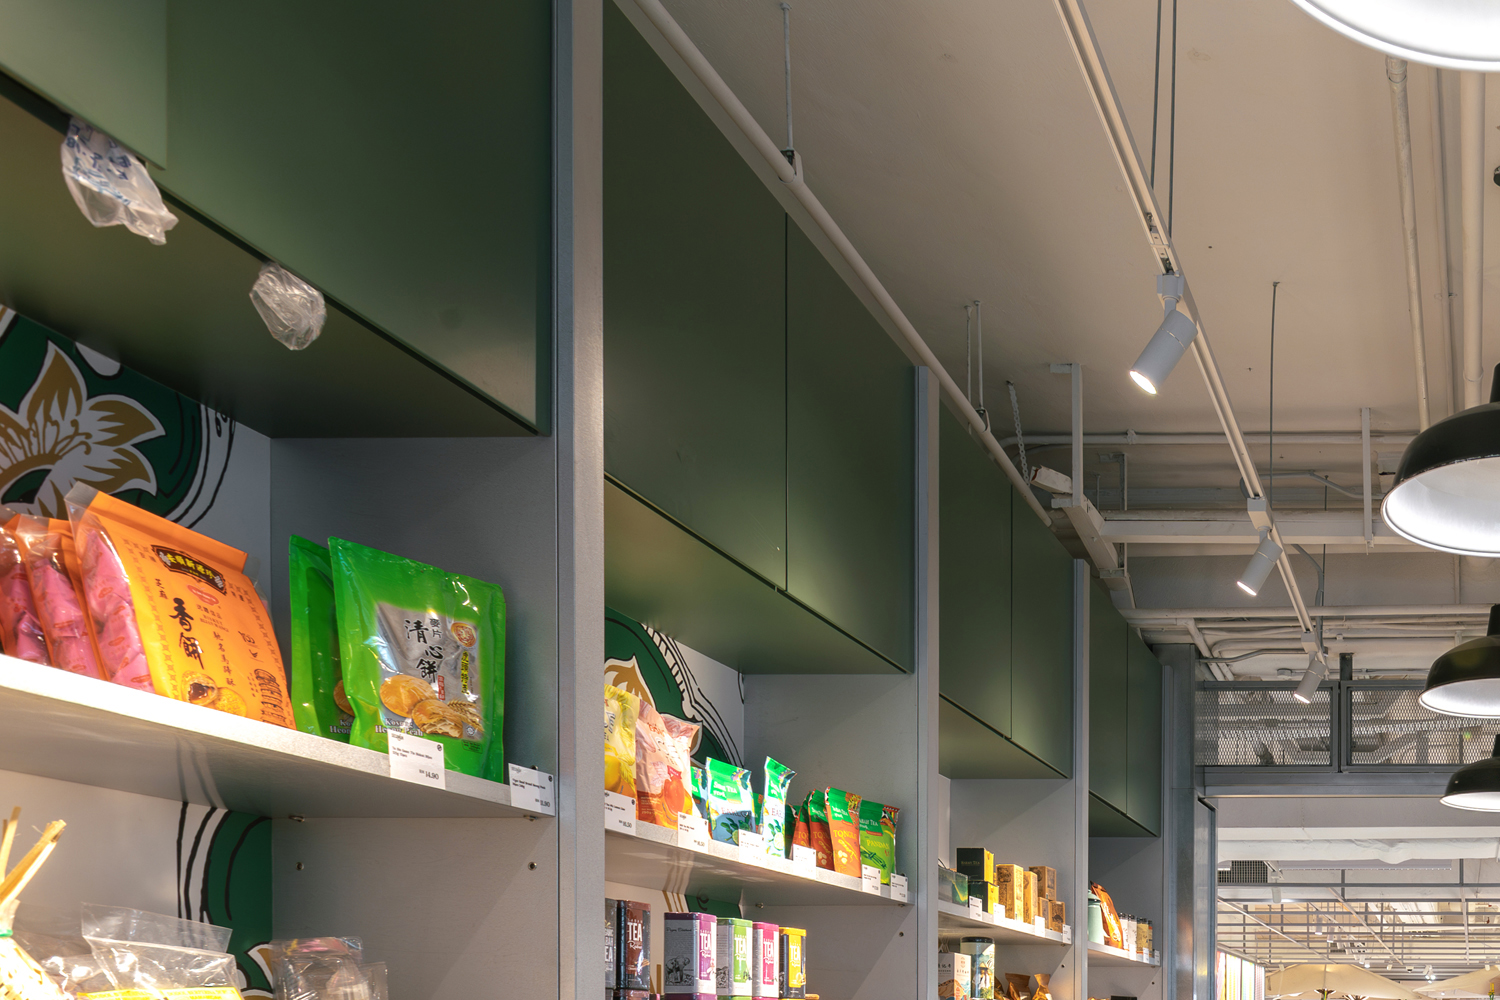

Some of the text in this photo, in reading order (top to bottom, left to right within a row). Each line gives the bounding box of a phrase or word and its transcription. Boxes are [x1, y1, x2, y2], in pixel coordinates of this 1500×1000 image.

[405, 619, 443, 683] 清心餅
[329, 725, 351, 735] Heon
[627, 922, 642, 942] TEA
[700, 933, 712, 950] TEA
[734, 936, 747, 954] TEA
[763, 940, 774, 958] TEA
[605, 946, 613, 962] EA
[790, 944, 801, 961] TEA
